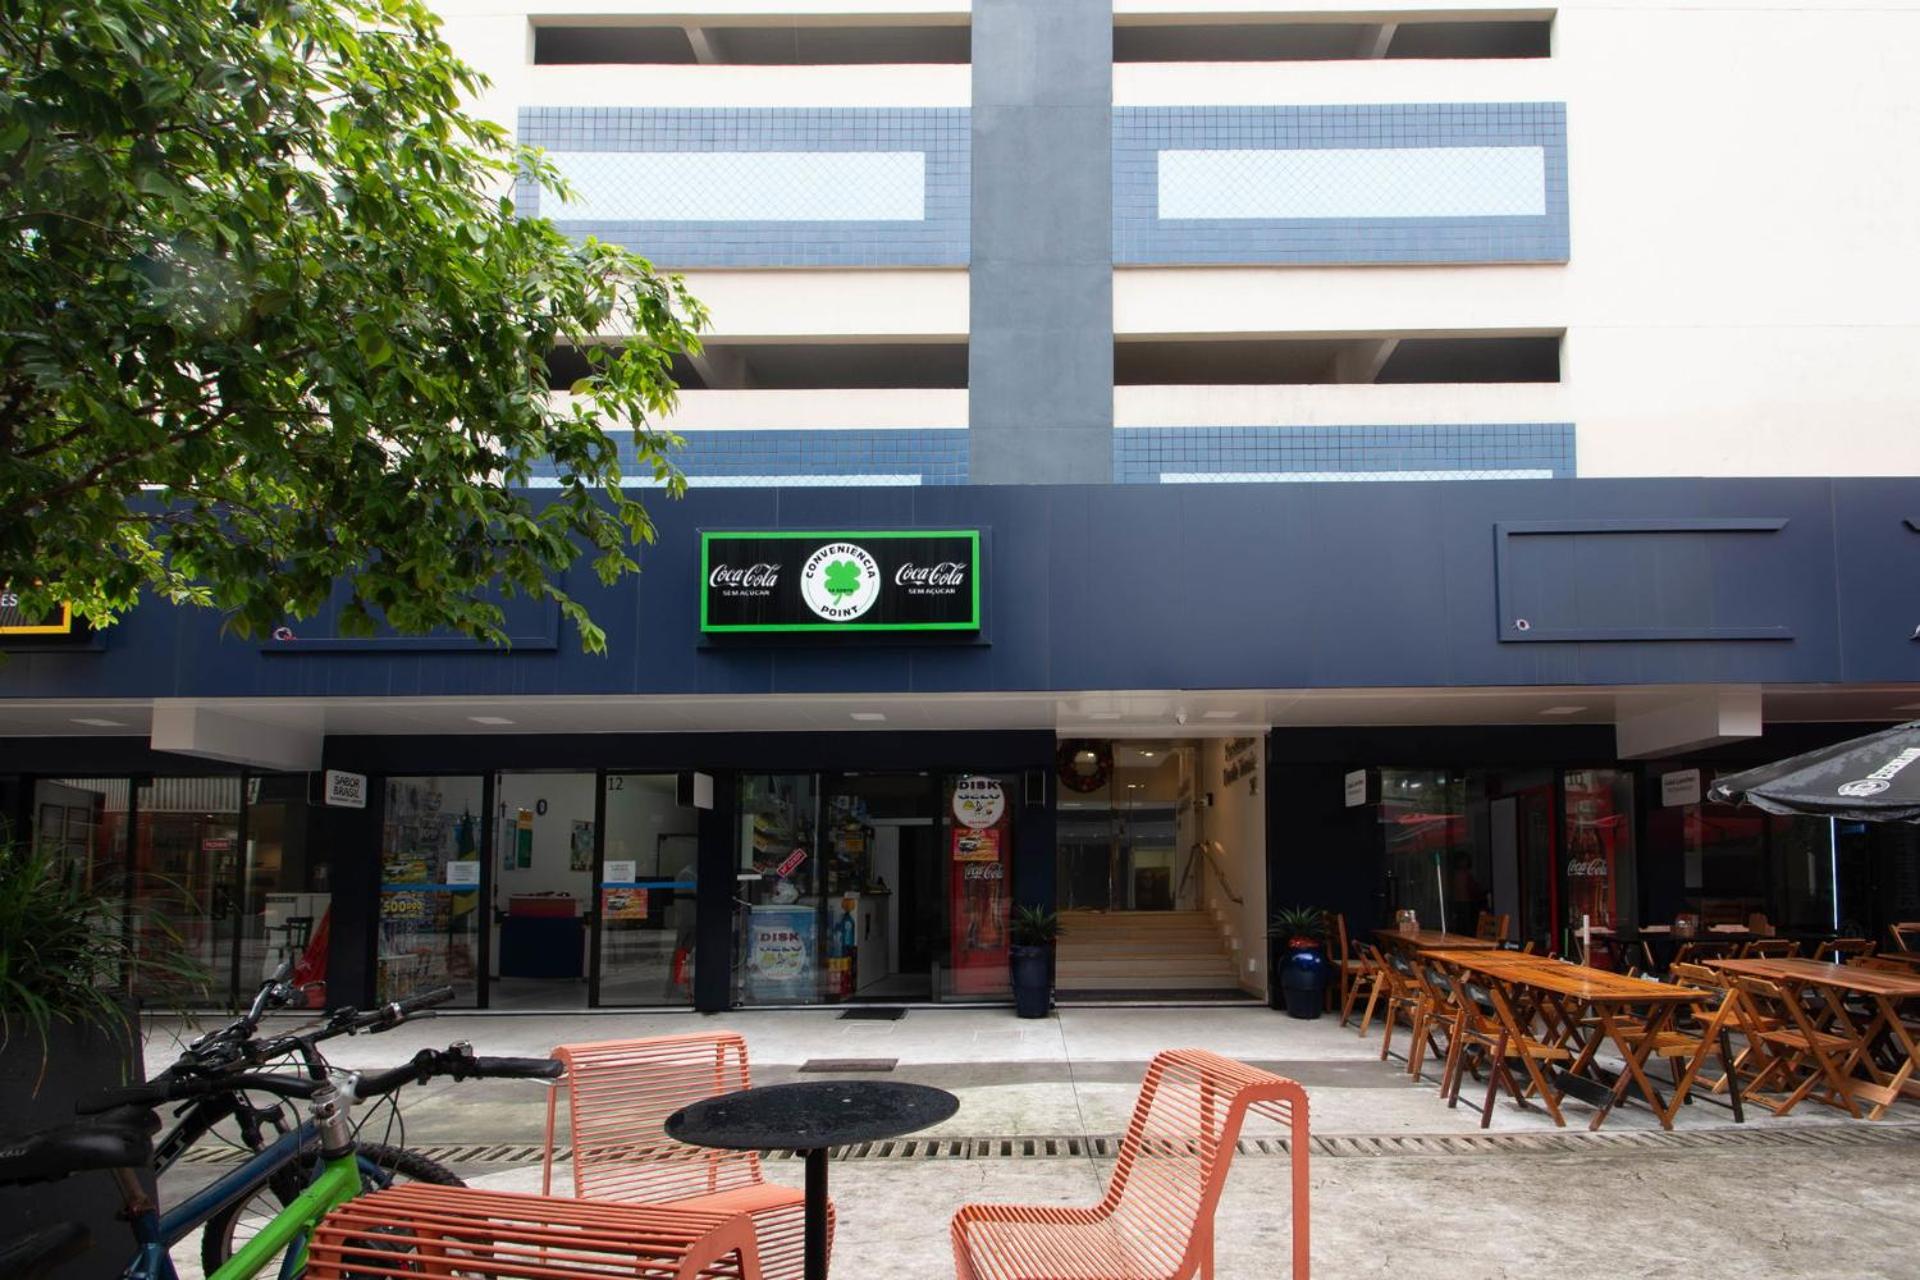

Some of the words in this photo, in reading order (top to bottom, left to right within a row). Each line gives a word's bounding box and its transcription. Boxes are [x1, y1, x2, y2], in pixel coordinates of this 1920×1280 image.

[820, 605, 858, 618] POINT
[607, 776, 624, 791] 12
[959, 780, 1000, 790] DISK
[760, 932, 800, 942] DISK
